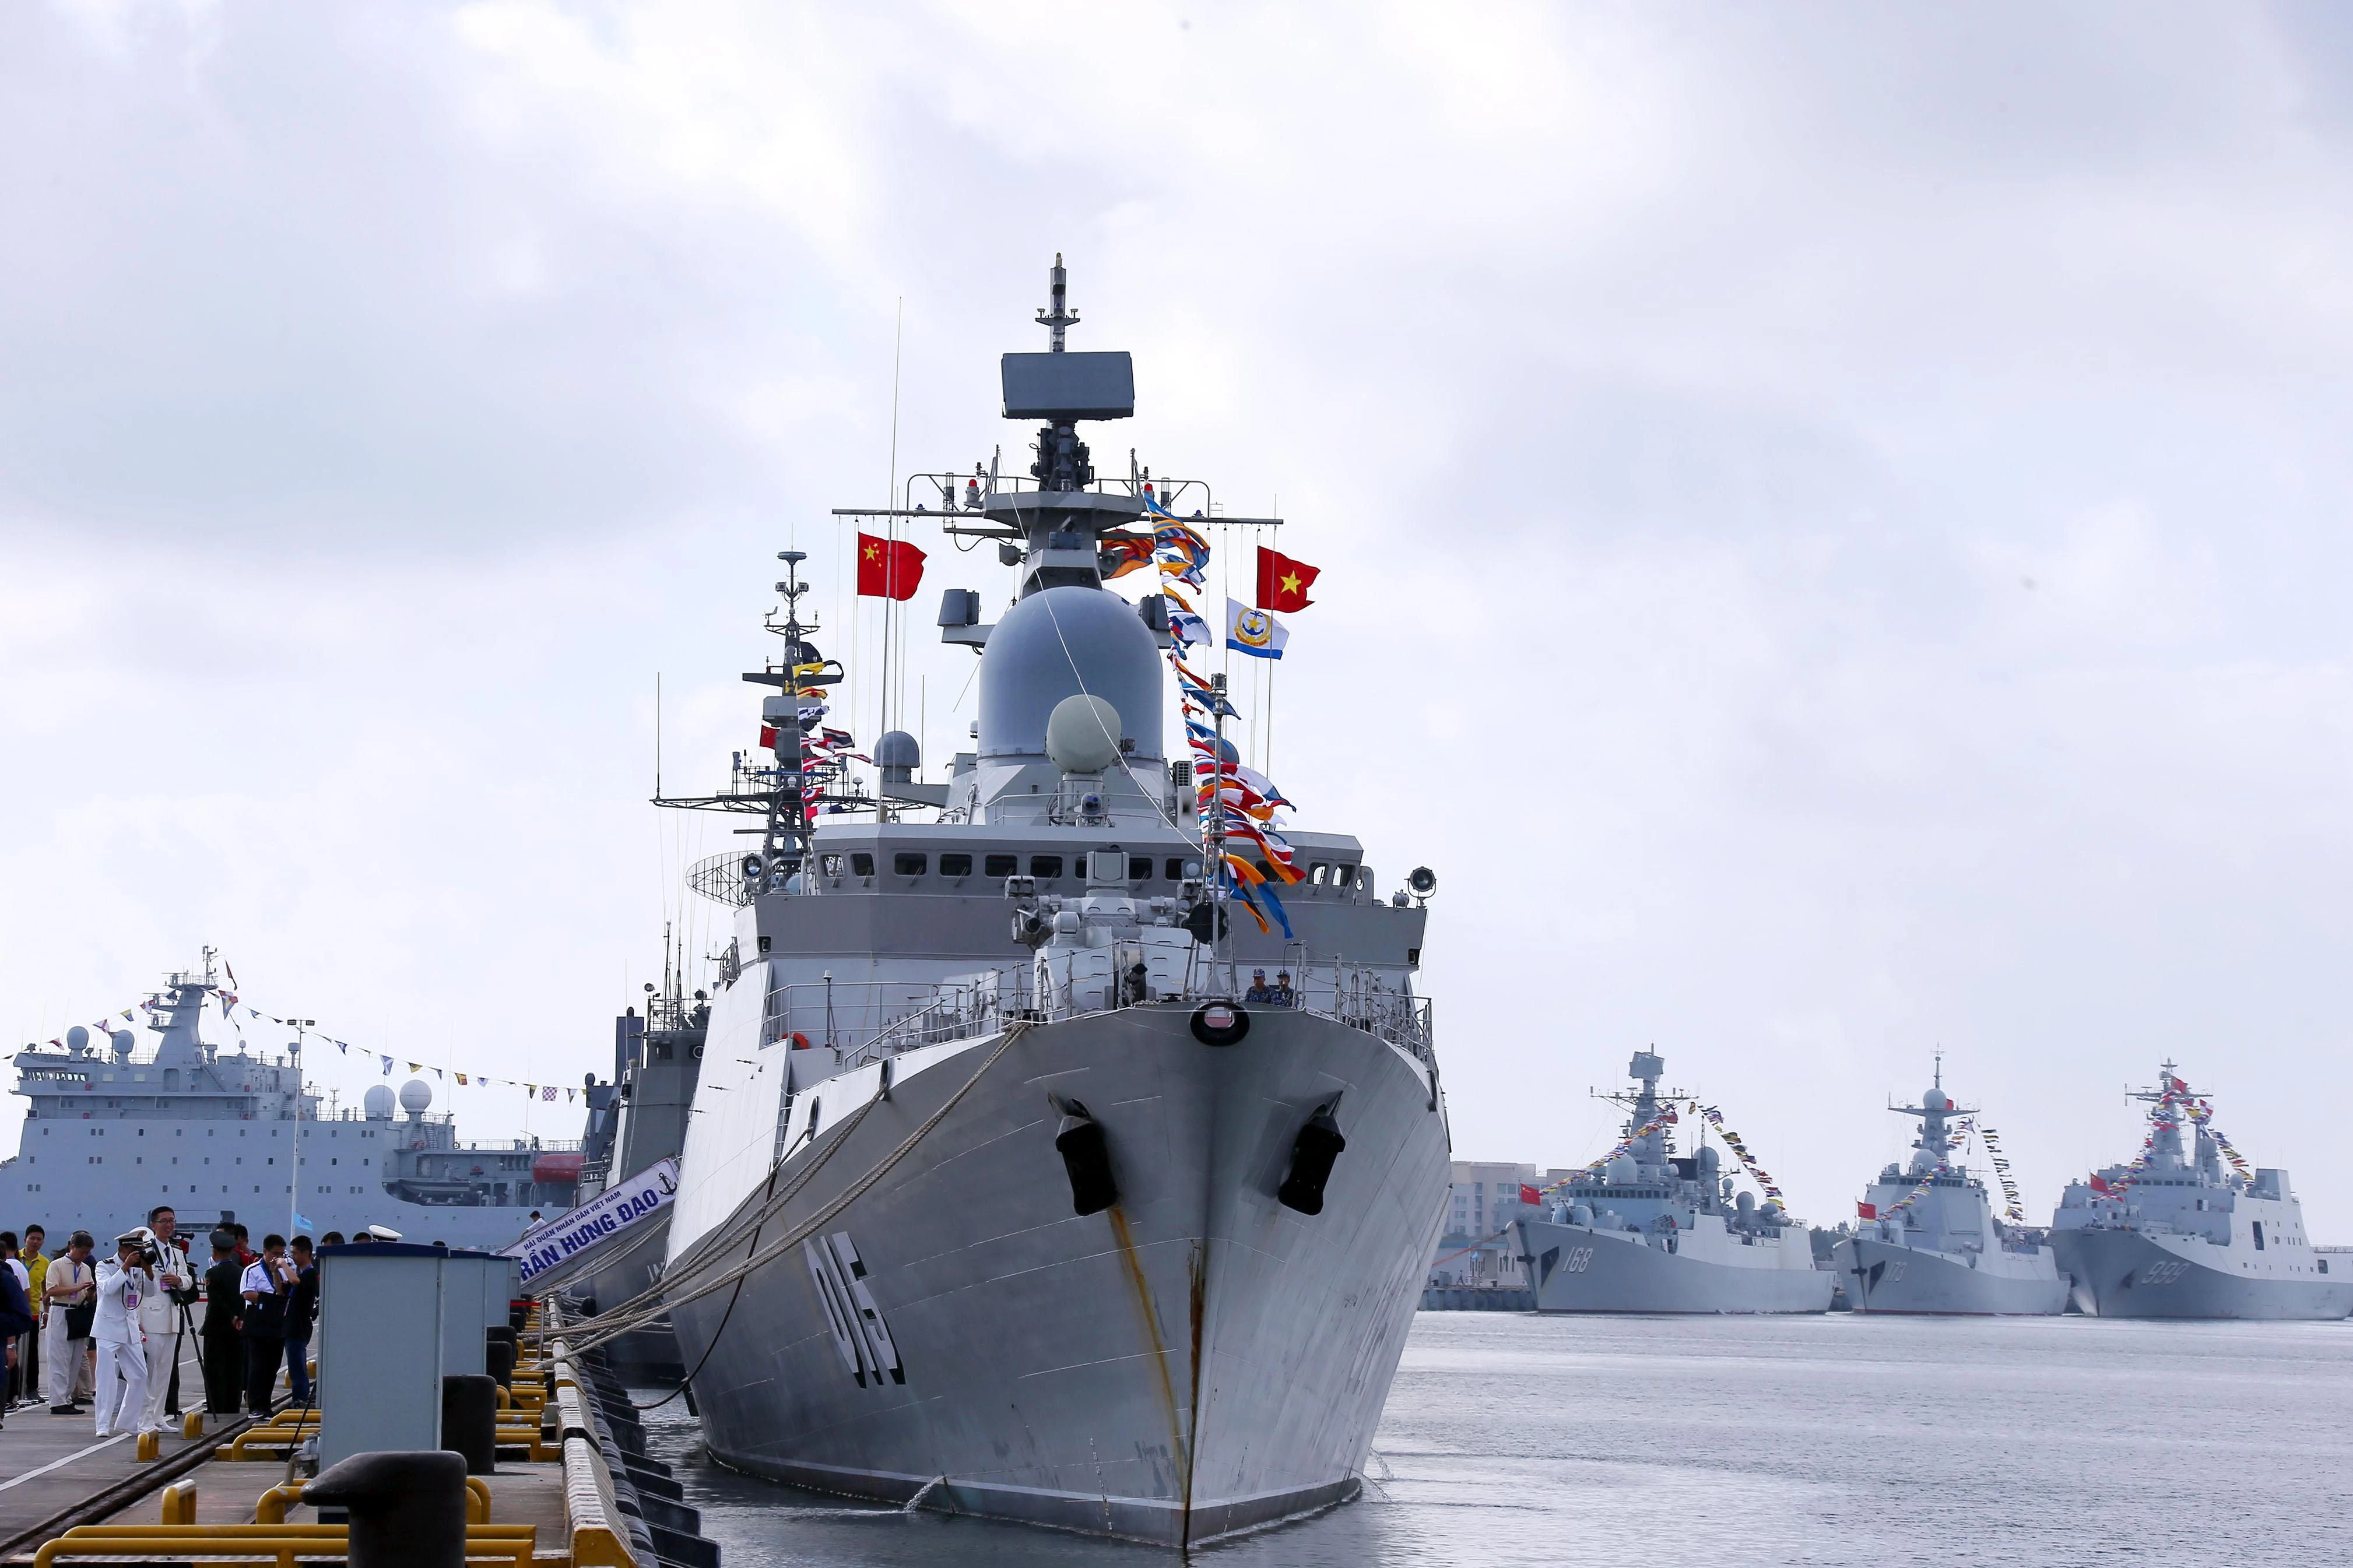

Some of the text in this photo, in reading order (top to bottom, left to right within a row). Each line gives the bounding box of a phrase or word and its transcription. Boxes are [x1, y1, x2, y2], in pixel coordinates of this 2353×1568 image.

[521, 1189, 659, 1281] RẦN HƯNG ĐẠO
[524, 1191, 621, 1250] HẢI QUÂN NHÂN DÂN VIỆT NAM
[1562, 1246, 1593, 1273] 168
[2140, 1260, 2190, 1285] 999
[803, 1231, 906, 1389] 015
